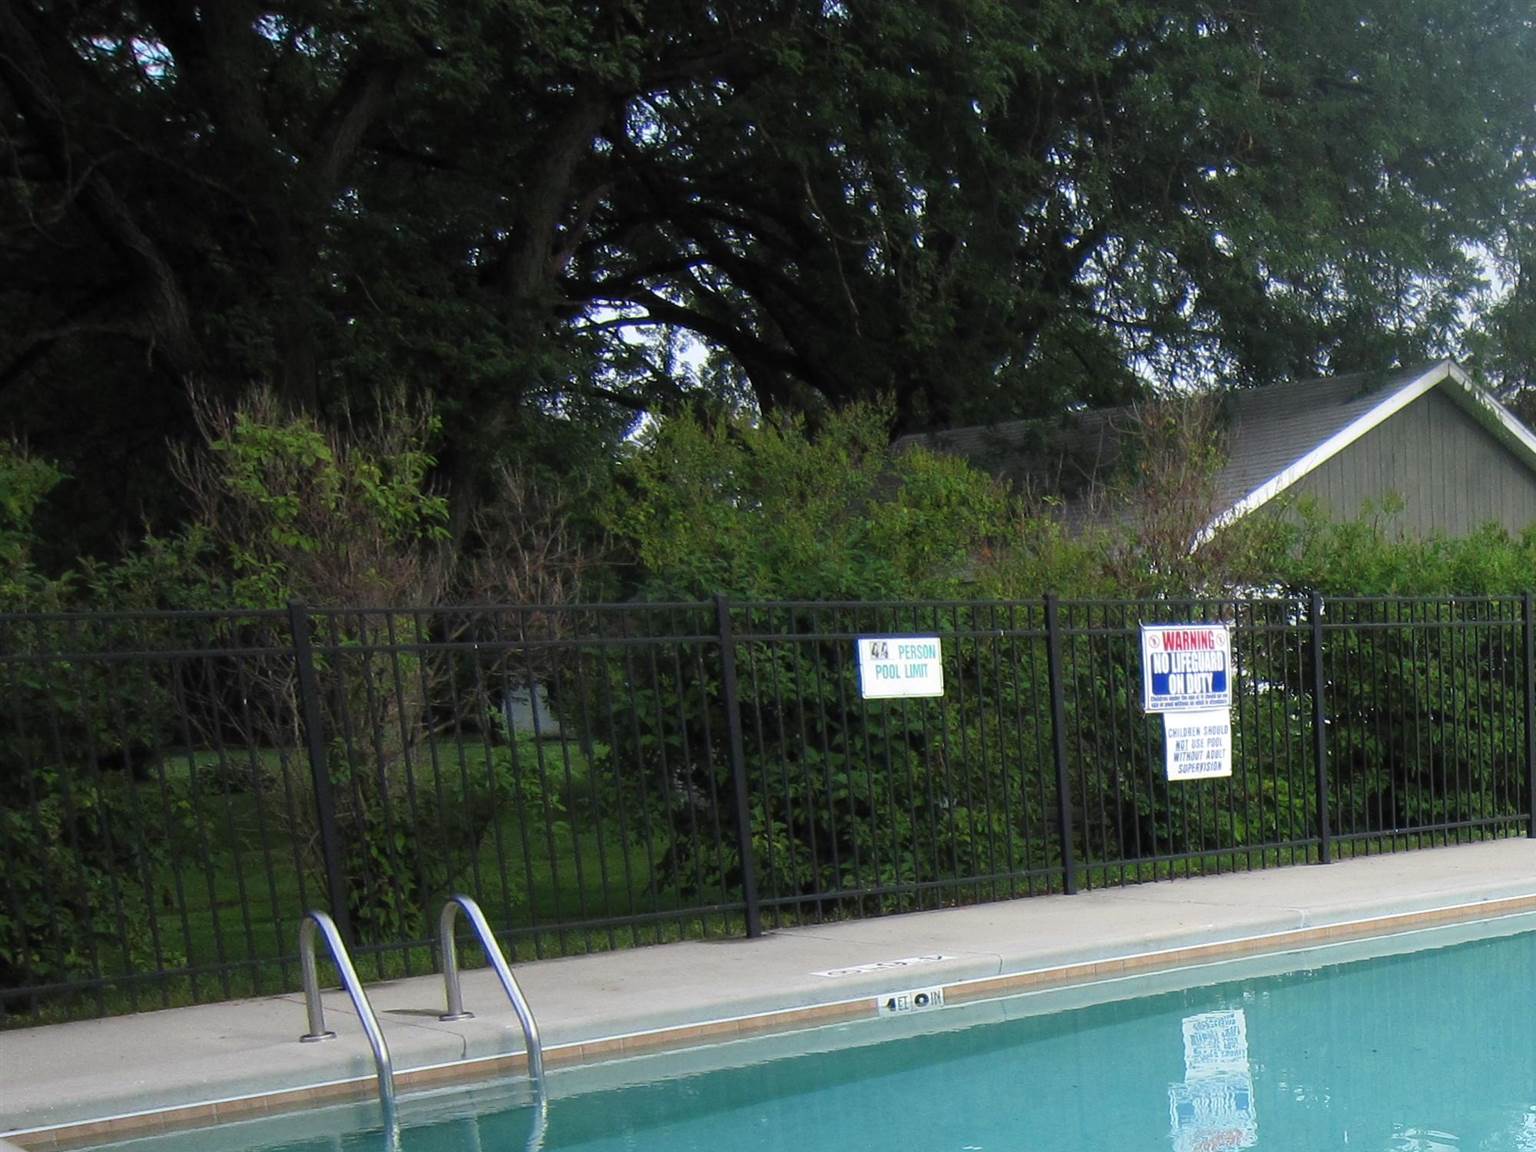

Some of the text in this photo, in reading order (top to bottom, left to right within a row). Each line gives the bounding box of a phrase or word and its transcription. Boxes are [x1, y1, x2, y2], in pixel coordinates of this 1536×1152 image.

[1162, 630, 1215, 651] WARNING
[898, 644, 936, 659] PERSON
[1153, 651, 1224, 674] NO LIFEGUARD
[875, 664, 928, 679] POOL LIMIT
[1168, 672, 1214, 694] ON DUTY
[1168, 725, 1229, 738] CHILDREN SHOULD
[1176, 737, 1223, 751] NOT USE POOL
[1173, 748, 1226, 762] WITHOUT ADULT
[1178, 762, 1222, 774] SUPERVISION
